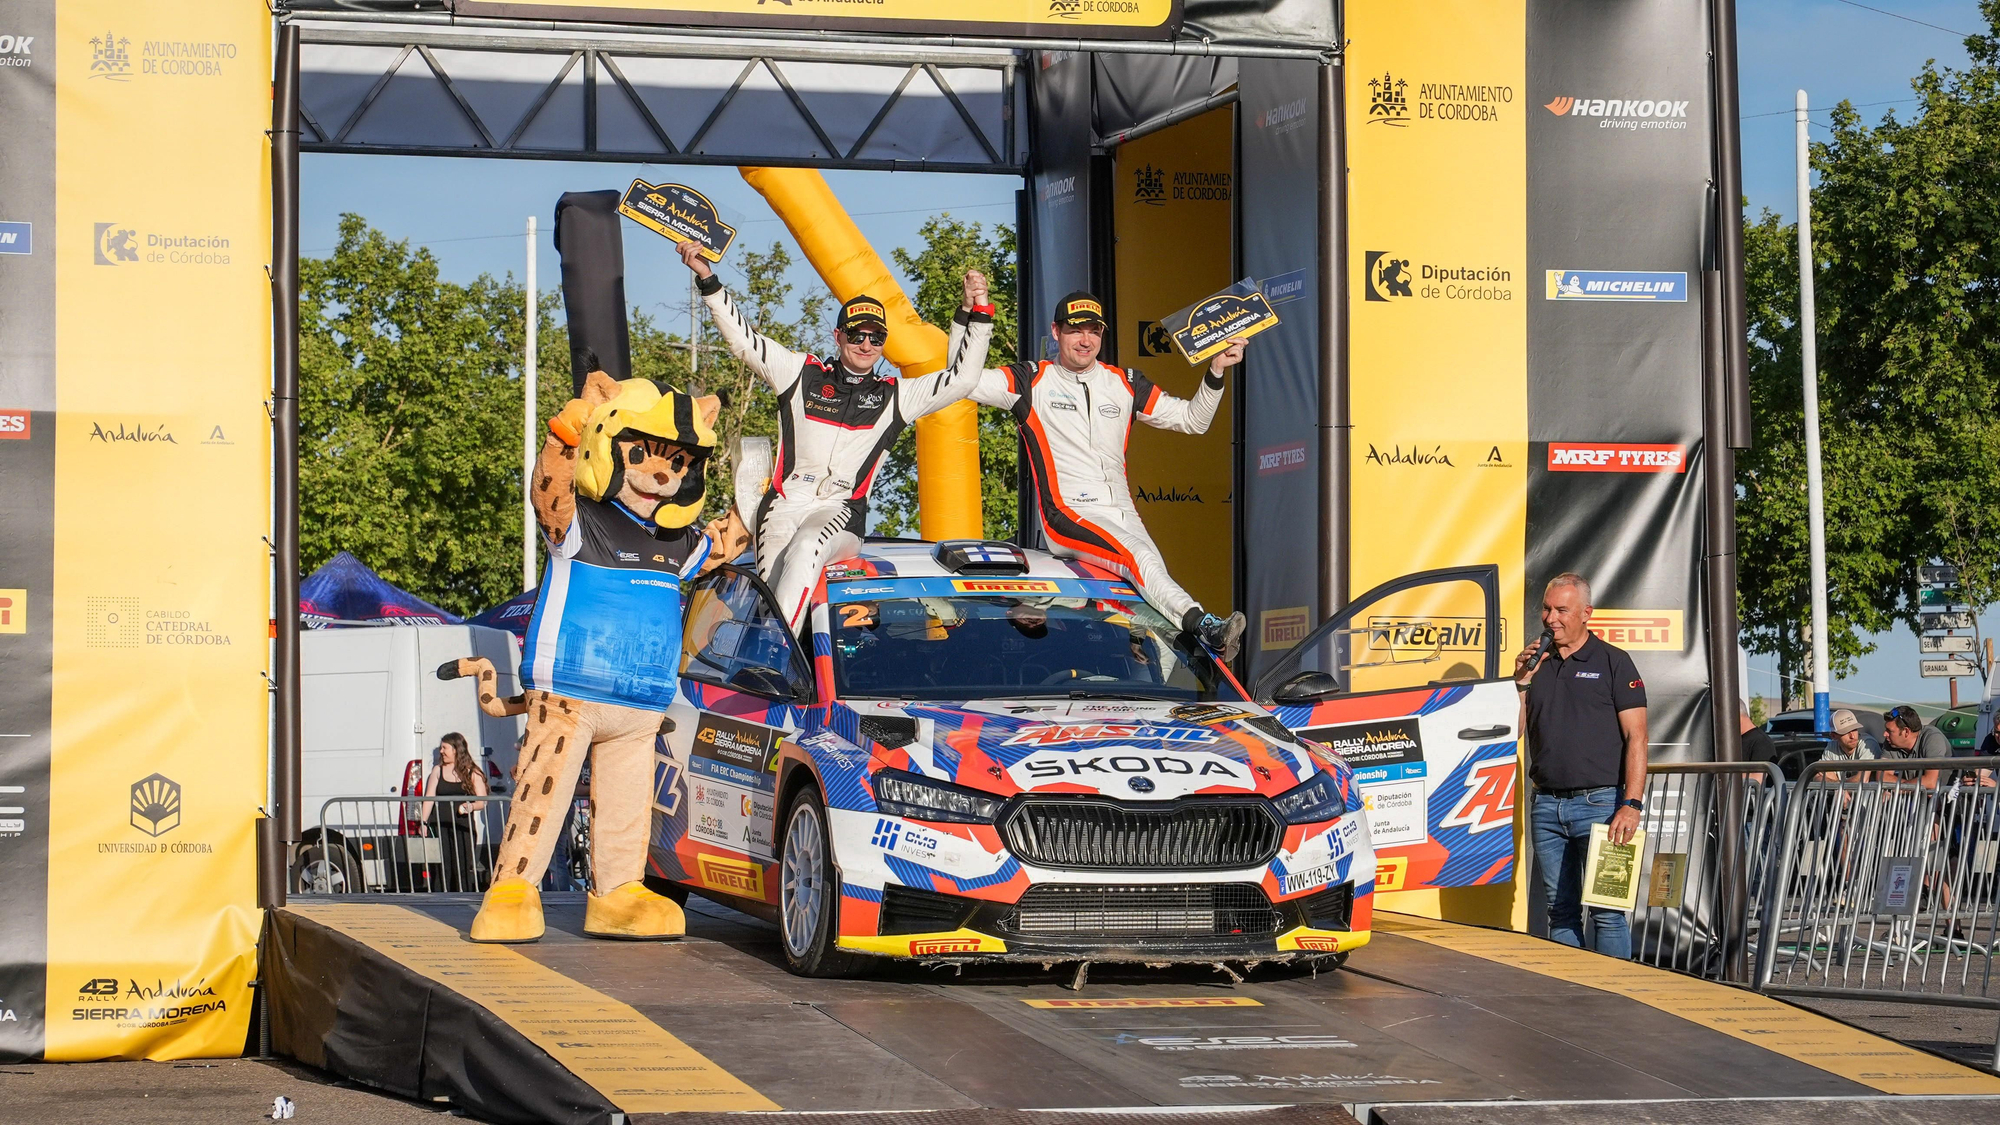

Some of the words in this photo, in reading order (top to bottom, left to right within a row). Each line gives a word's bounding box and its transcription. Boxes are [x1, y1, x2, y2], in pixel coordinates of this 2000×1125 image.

[142, 41, 237, 59] AYUNTAMIENTO
[143, 59, 158, 74] DE
[1419, 83, 1513, 103] AYUNTAMIENTO
[1420, 102, 1434, 119] DE
[1600, 119, 1637, 131] driving
[1641, 121, 1687, 129] emotion
[637, 201, 670, 223] SIERRA
[672, 219, 712, 245] MORENA
[147, 234, 230, 250] Diputación
[147, 251, 165, 264] de
[169, 251, 230, 265] Córdoba
[1422, 264, 1511, 283] Diputación
[1270, 279, 1303, 296] MICHELIN
[1421, 283, 1440, 298] de
[1445, 284, 1512, 300] Córdoba
[1585, 280, 1675, 293] MICHELIN
[1194, 330, 1225, 349] SIERRA
[1224, 312, 1262, 334] MORENA
[89, 422, 178, 445] Andalucía
[1259, 451, 1282, 470] MRF
[1283, 447, 1305, 467] TYRES
[1365, 443, 1455, 468] Andalucía
[1552, 449, 1615, 466] MRF
[1618, 450, 1682, 466] TYRES
[1135, 486, 1204, 504] Andalucía
[963, 581, 1050, 592] PIRELLI
[146, 610, 190, 619] CABILDO
[838, 604, 874, 628] 2
[146, 621, 212, 633] CATEDRAL
[1265, 615, 1305, 644] PIRELLI
[1393, 621, 1482, 646] Recalvi
[146, 634, 163, 646] DE
[167, 632, 232, 647] CÓRDOBA
[697, 727, 716, 744] 43
[716, 730, 735, 740] RALLY
[735, 729, 760, 748] Andalucía
[1333, 738, 1365, 748] RALLY
[1365, 728, 1410, 744] Andalucía
[711, 763, 719, 773] FIA
[720, 766, 729, 777] ERC
[729, 769, 762, 787] Championship
[1377, 792, 1412, 802] Diputación
[1386, 799, 1412, 808] Córdoba
[1374, 820, 1390, 829] Junta
[1382, 824, 1410, 834] Andalucía
[98, 843, 157, 854] UNIVERSIDAD
[170, 841, 213, 854] CÓRDOBA
[702, 861, 759, 893] PIRELLI
[1286, 863, 1336, 893] WW-119-ZY
[909, 938, 981, 956] PIRELLI
[1294, 936, 1339, 951] PIRELLI
[79, 978, 119, 994] 43
[126, 978, 217, 1000] Andalucía
[72, 1008, 143, 1020] SIERRA
[149, 1000, 226, 1019] MORENA
